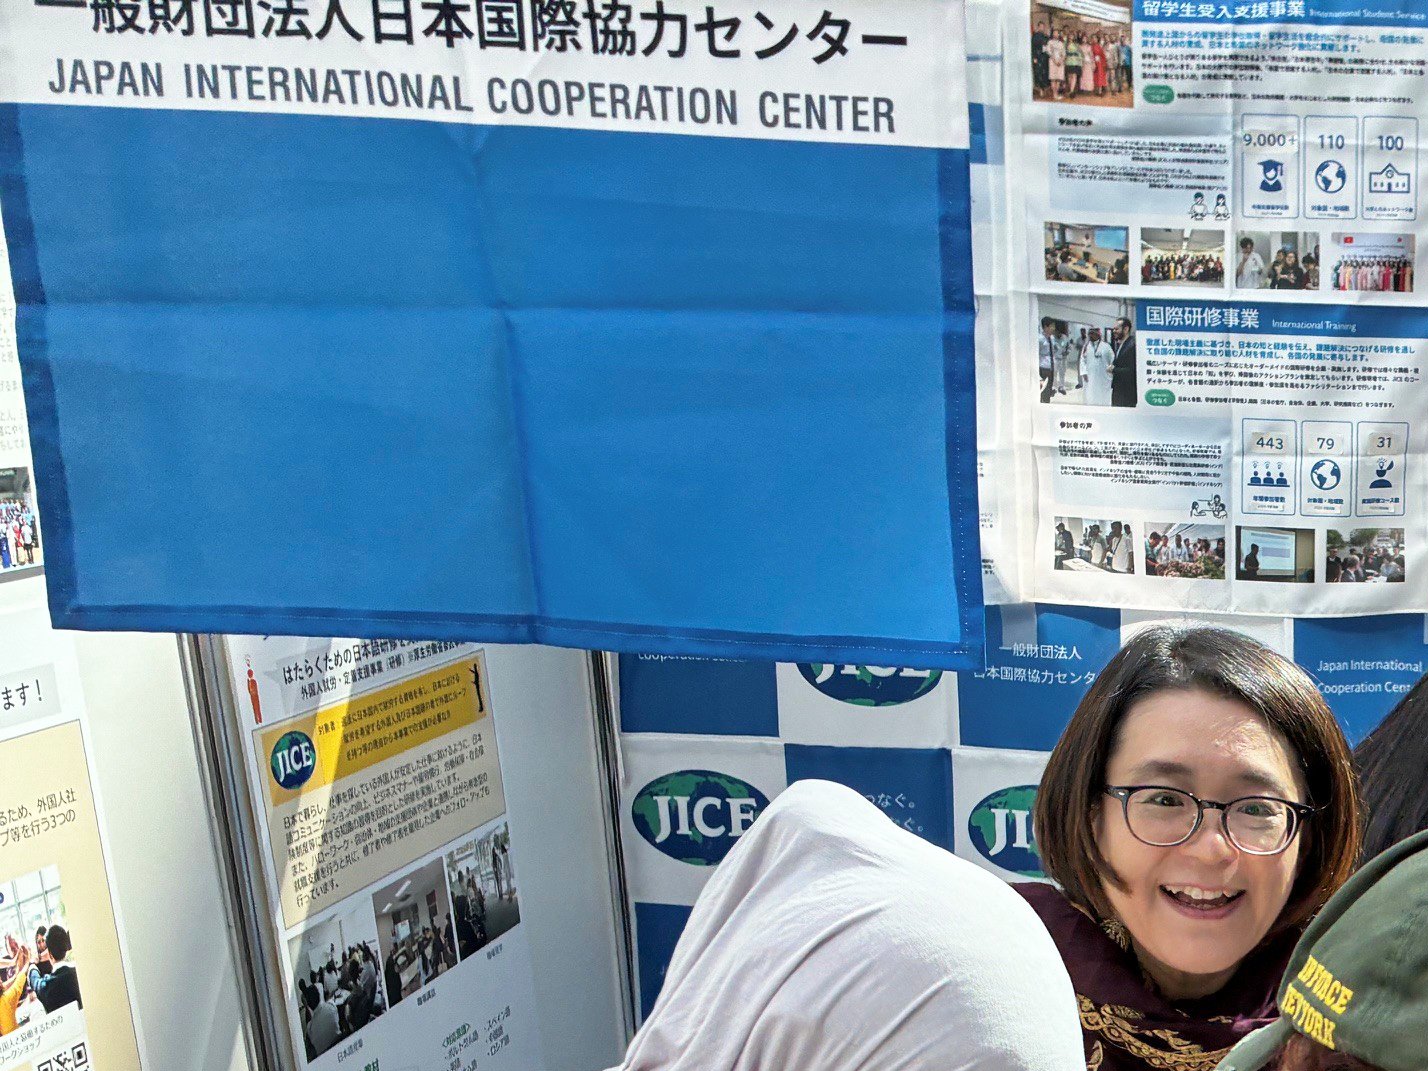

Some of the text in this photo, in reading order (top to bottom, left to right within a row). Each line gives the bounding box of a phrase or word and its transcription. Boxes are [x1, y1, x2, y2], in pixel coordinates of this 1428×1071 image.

[1142, 0, 1306, 19] 留学生受入支援事業
[33, 0, 909, 64] 一般財団法人日本国際協力センター
[48, 59, 896, 134] JAPAN INTERNATIONAL COOPERATION CENTER
[1318, 134, 1345, 150] 110
[1378, 135, 1404, 150] 100
[1145, 306, 1260, 330] 国際研修事業
[1272, 318, 1357, 333] International Training
[1256, 437, 1284, 450] 443
[1316, 437, 1335, 450] 79
[1376, 436, 1392, 449] 31
[999, 643, 1082, 660] 一般財団法人
[1317, 660, 1422, 673] Japan International
[974, 665, 1097, 685] 本国際協力センタ
[1, 679, 42, 711] ます！
[1317, 682, 1382, 696] Cooperation
[275, 741, 315, 780] JICE
[865, 793, 915, 809] つなぐ。
[652, 795, 758, 844] JICE
